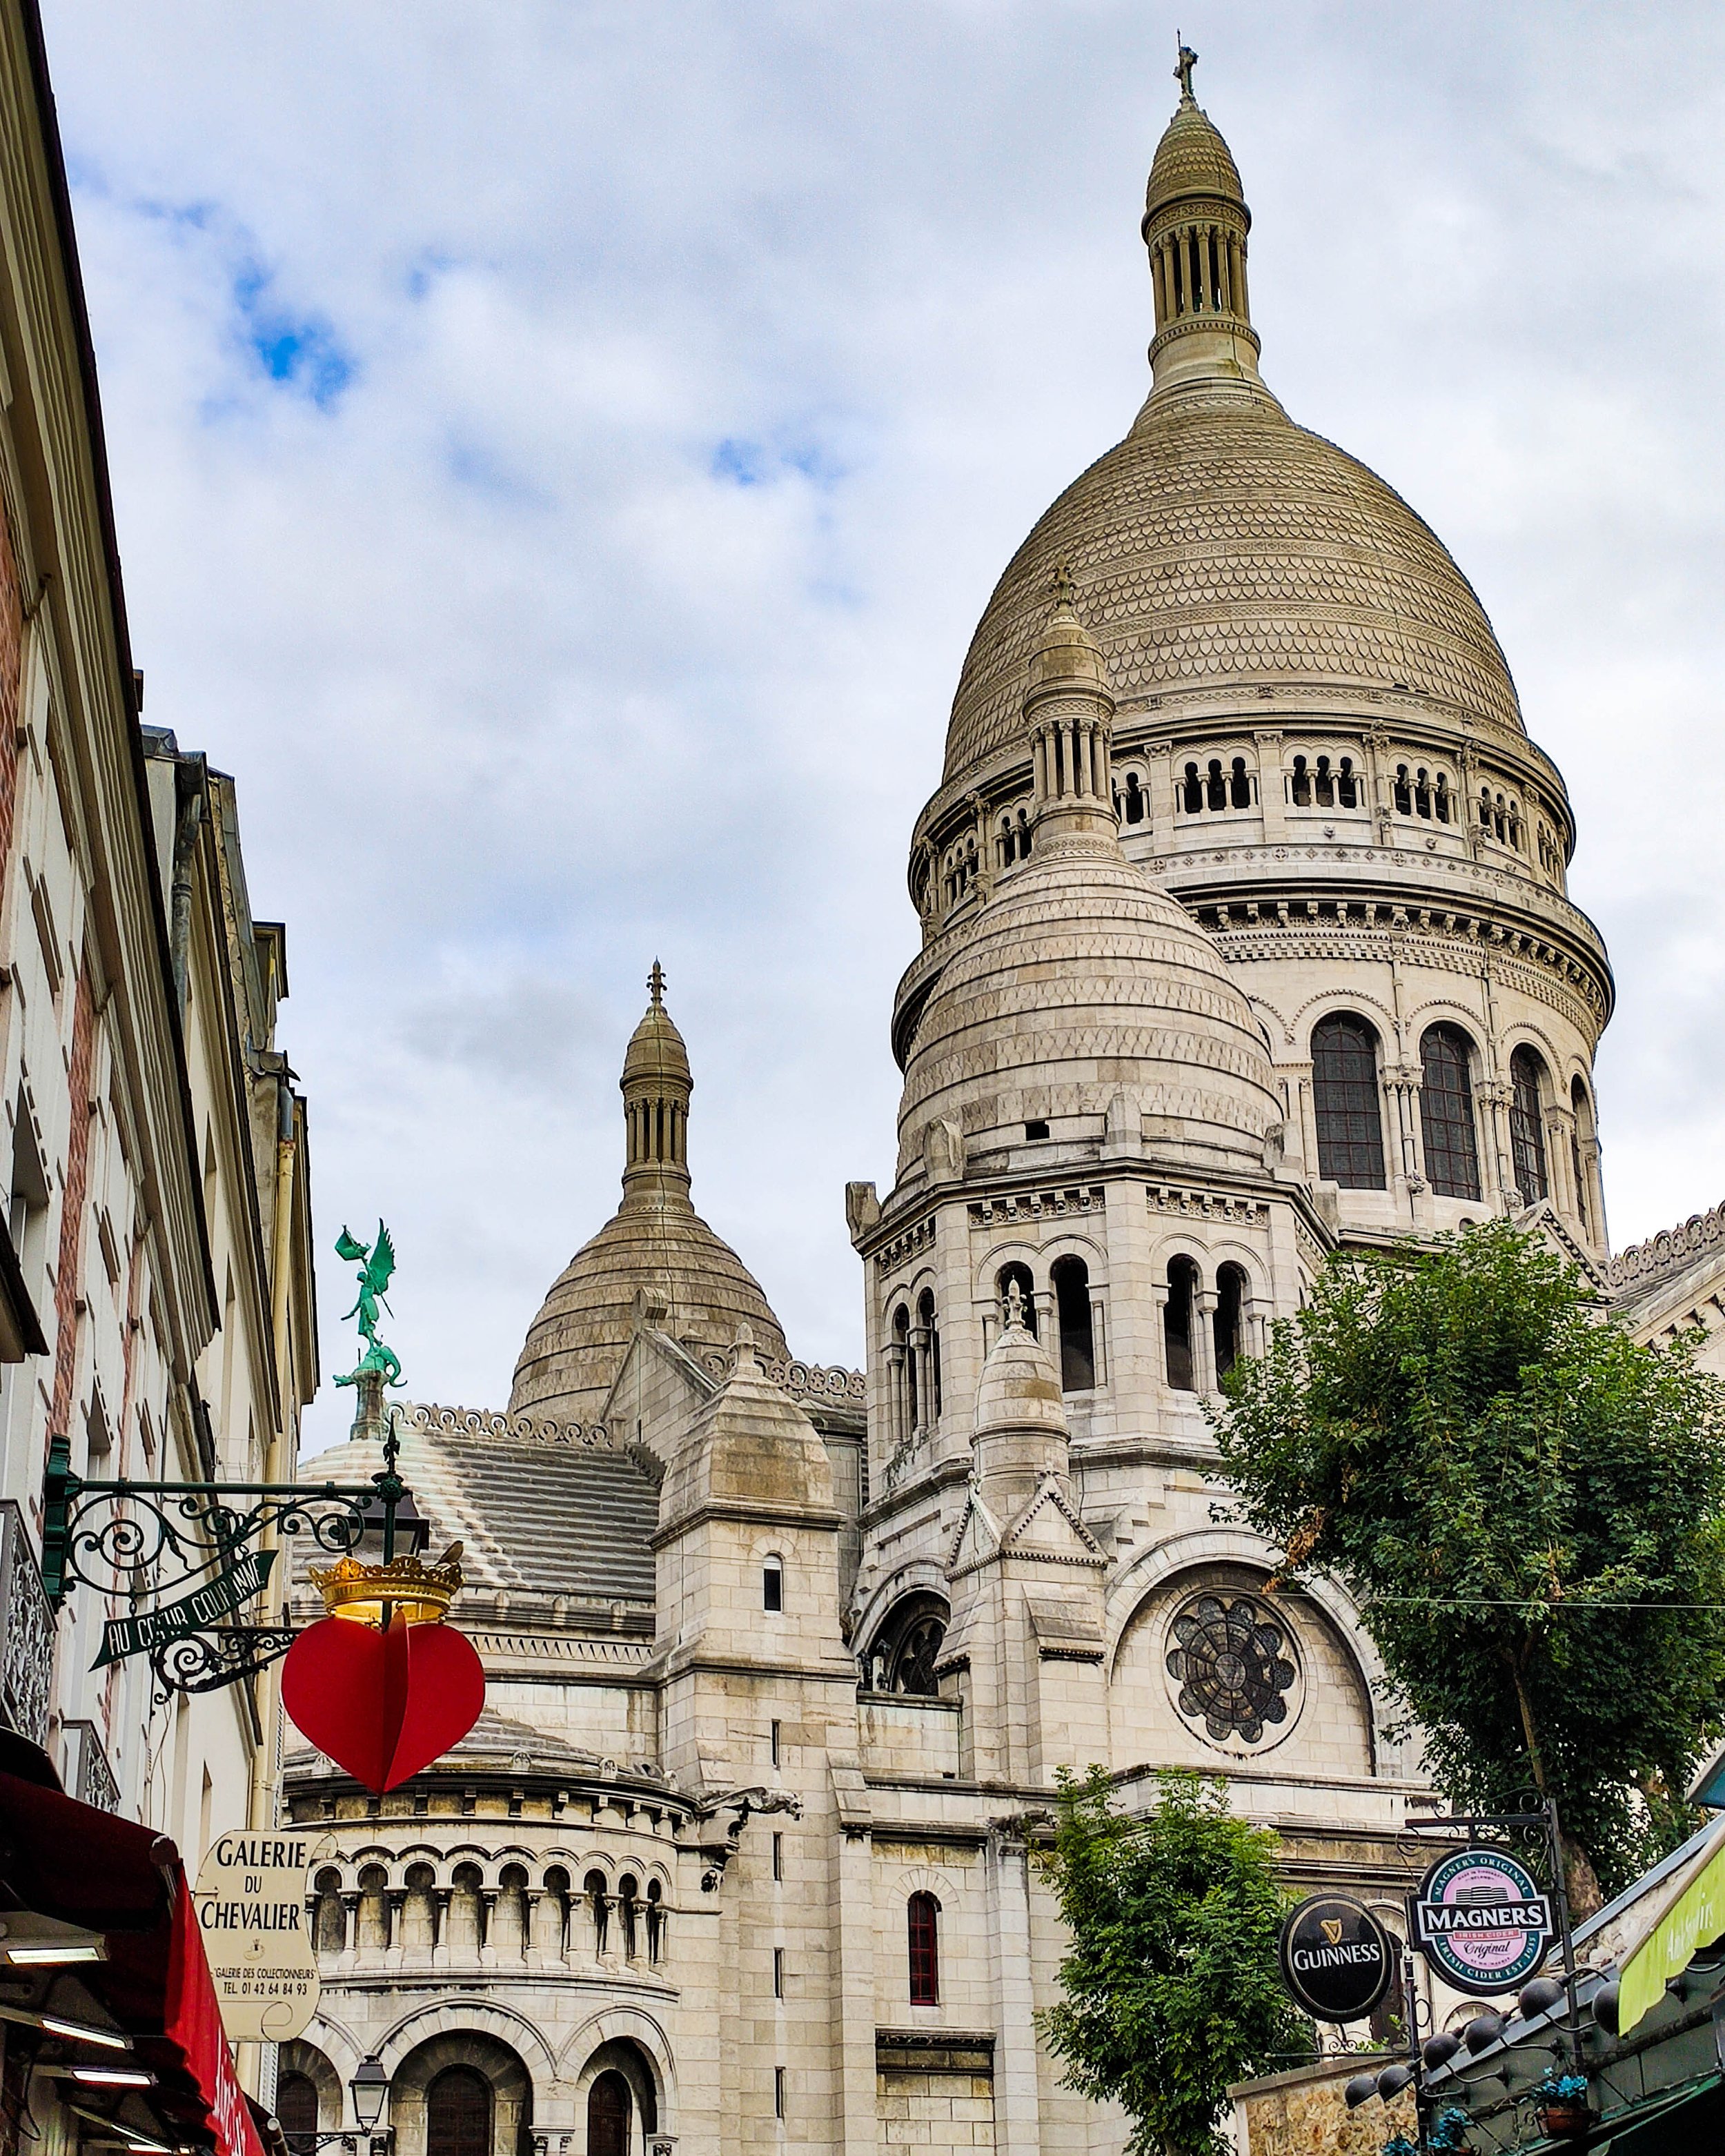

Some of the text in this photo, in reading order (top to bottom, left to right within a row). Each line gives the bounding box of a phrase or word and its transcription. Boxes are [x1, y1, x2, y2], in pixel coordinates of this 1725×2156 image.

[108, 1622, 131, 1656] AU
[217, 1839, 306, 1868] GALERIE
[245, 1875, 262, 1894] DU
[1479, 1857, 1530, 1893] ORIGINAL
[201, 1901, 299, 1930] CHEVALIER
[1426, 1905, 1544, 1930] MAGNERS
[1293, 1943, 1380, 1971] GUINNESS
[1439, 1941, 1464, 1970] IRISH
[1467, 1967, 1503, 1979] CIDER
[1463, 1941, 1511, 1959] Original
[243, 1968, 255, 1979] DES
[242, 1982, 250, 1995] 01
[254, 1983, 265, 1995] 42
[268, 1983, 279, 1995] 64
[283, 1983, 293, 1996] 84
[297, 1983, 307, 1995] 93
